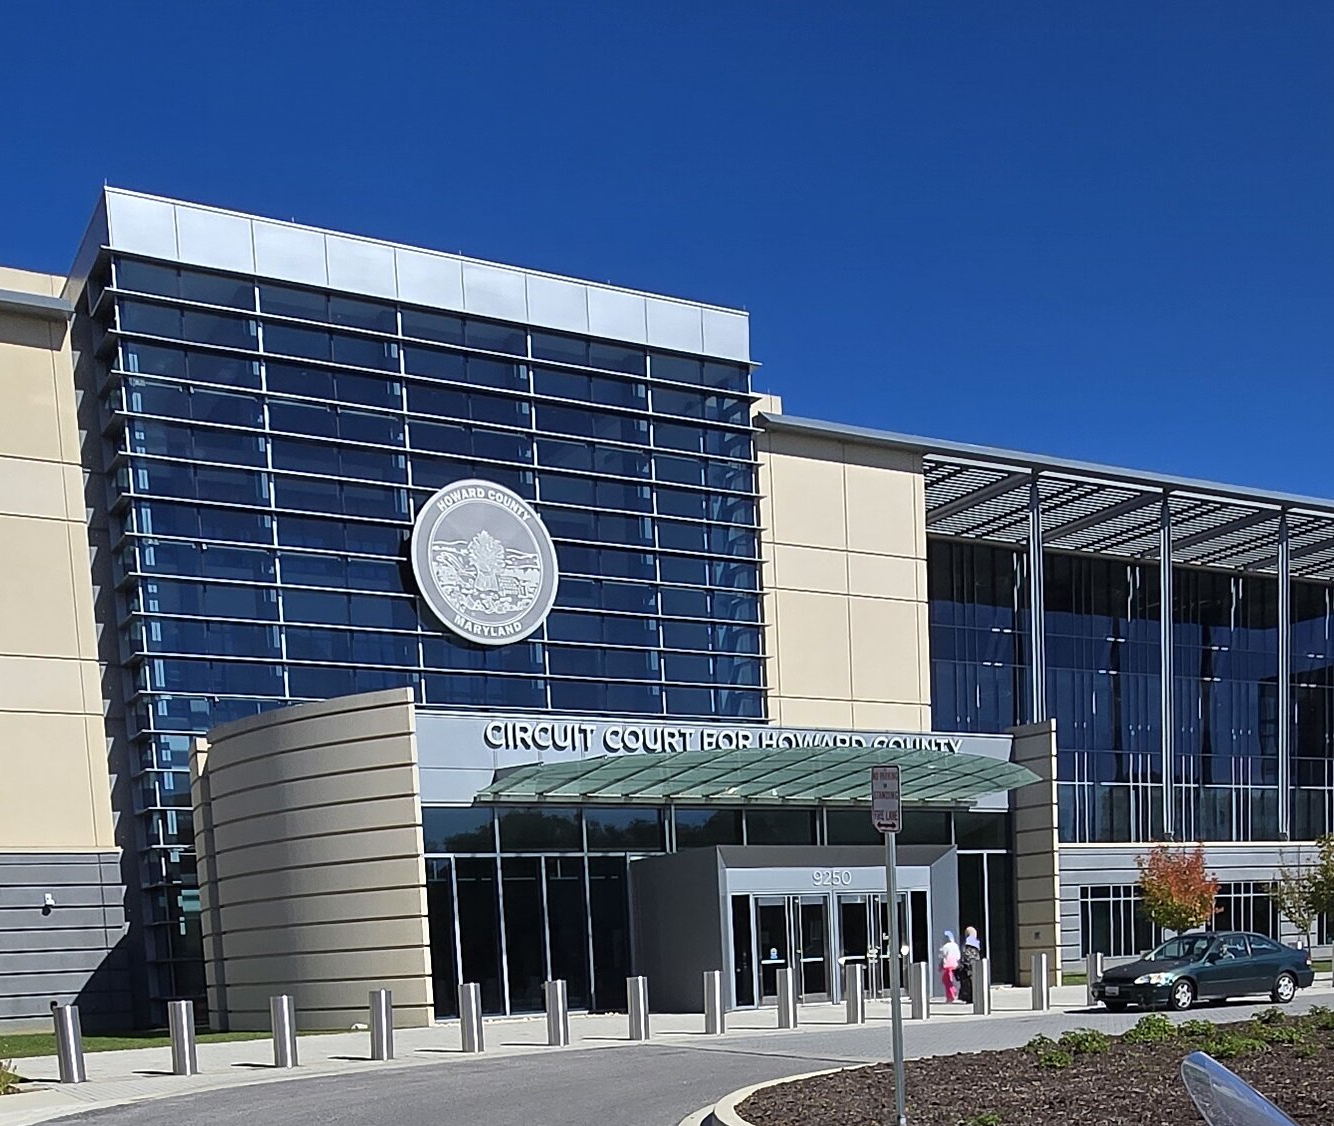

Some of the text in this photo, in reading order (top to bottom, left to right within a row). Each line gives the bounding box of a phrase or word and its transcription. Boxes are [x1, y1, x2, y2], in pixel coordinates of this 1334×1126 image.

[437, 488, 531, 521] HOWARD COUNTY
[453, 614, 522, 637] MARYLAND
[485, 720, 596, 750] CIRCUIT
[602, 725, 693, 753] COURT
[701, 728, 753, 751] FOR
[813, 870, 852, 886] 9250
